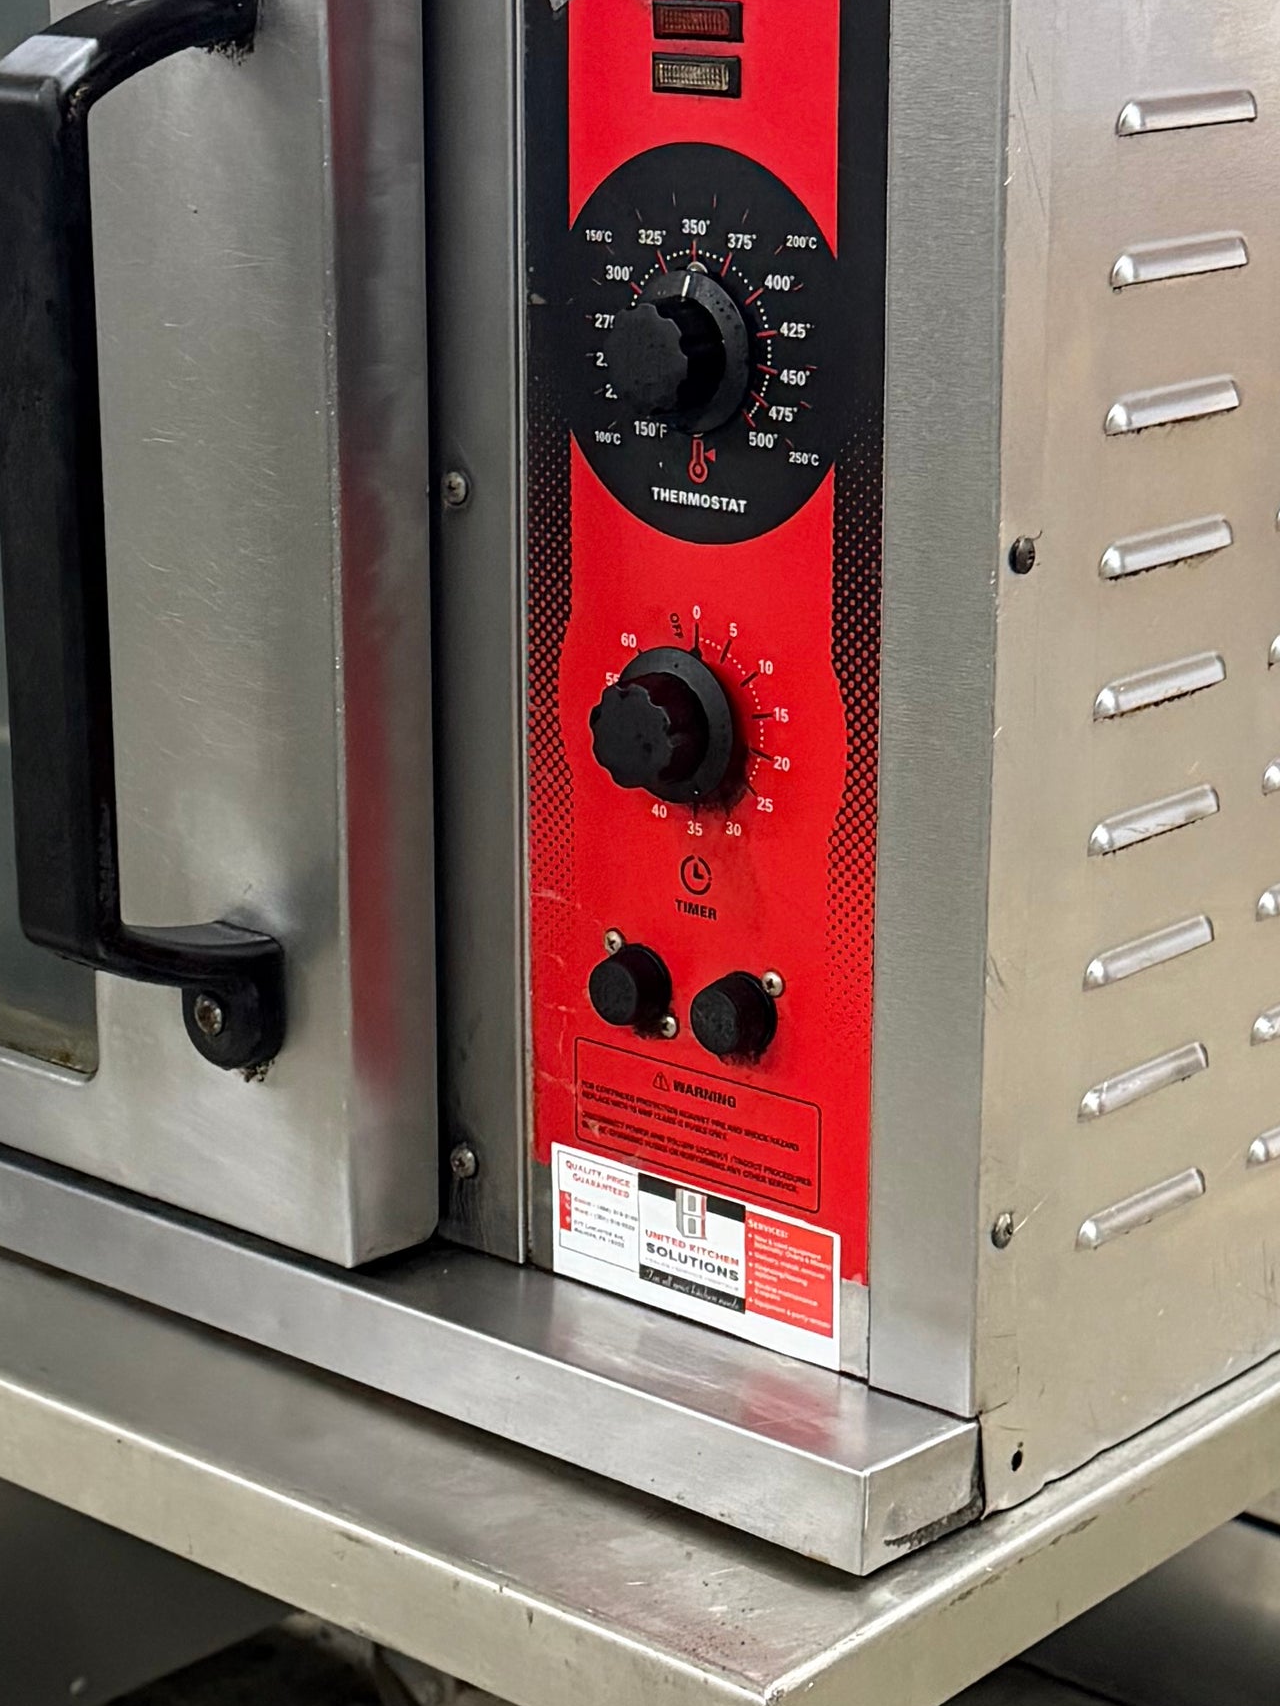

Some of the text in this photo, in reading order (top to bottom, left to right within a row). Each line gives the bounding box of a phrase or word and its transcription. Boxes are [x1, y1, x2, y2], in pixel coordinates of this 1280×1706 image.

[682, 219, 710, 236] 350°
[638, 229, 666, 246] 325°
[727, 233, 757, 250] 375°
[606, 265, 634, 282] 300°
[764, 274, 795, 291] 400°
[594, 313, 615, 329] 27
[779, 369, 811, 386] 450°
[768, 406, 798, 423] 475°
[748, 432, 778, 449] 500°
[651, 486, 748, 514] THERMOSTAT
[692, 605, 701, 620] 0
[670, 613, 684, 638] OFF
[729, 622, 738, 638] 5
[621, 632, 637, 648] 60
[758, 659, 774, 675] 10
[773, 707, 789, 723] 15
[773, 755, 790, 771] 20
[651, 803, 667, 818] 40
[756, 796, 774, 813] 25
[687, 820, 703, 836] 35
[726, 821, 741, 837] 30
[675, 898, 717, 921] TIMER
[673, 1080, 737, 1109] WARNING
[566, 1160, 631, 1188] QUALITY, PRICE
[573, 1173, 630, 1199] GUARANTEED
[748, 1218, 789, 1239] SERVICES:
[645, 1228, 686, 1248] UNITED
[689, 1244, 739, 1266] KITCHEN
[646, 1242, 739, 1281] SOLUTIONS
